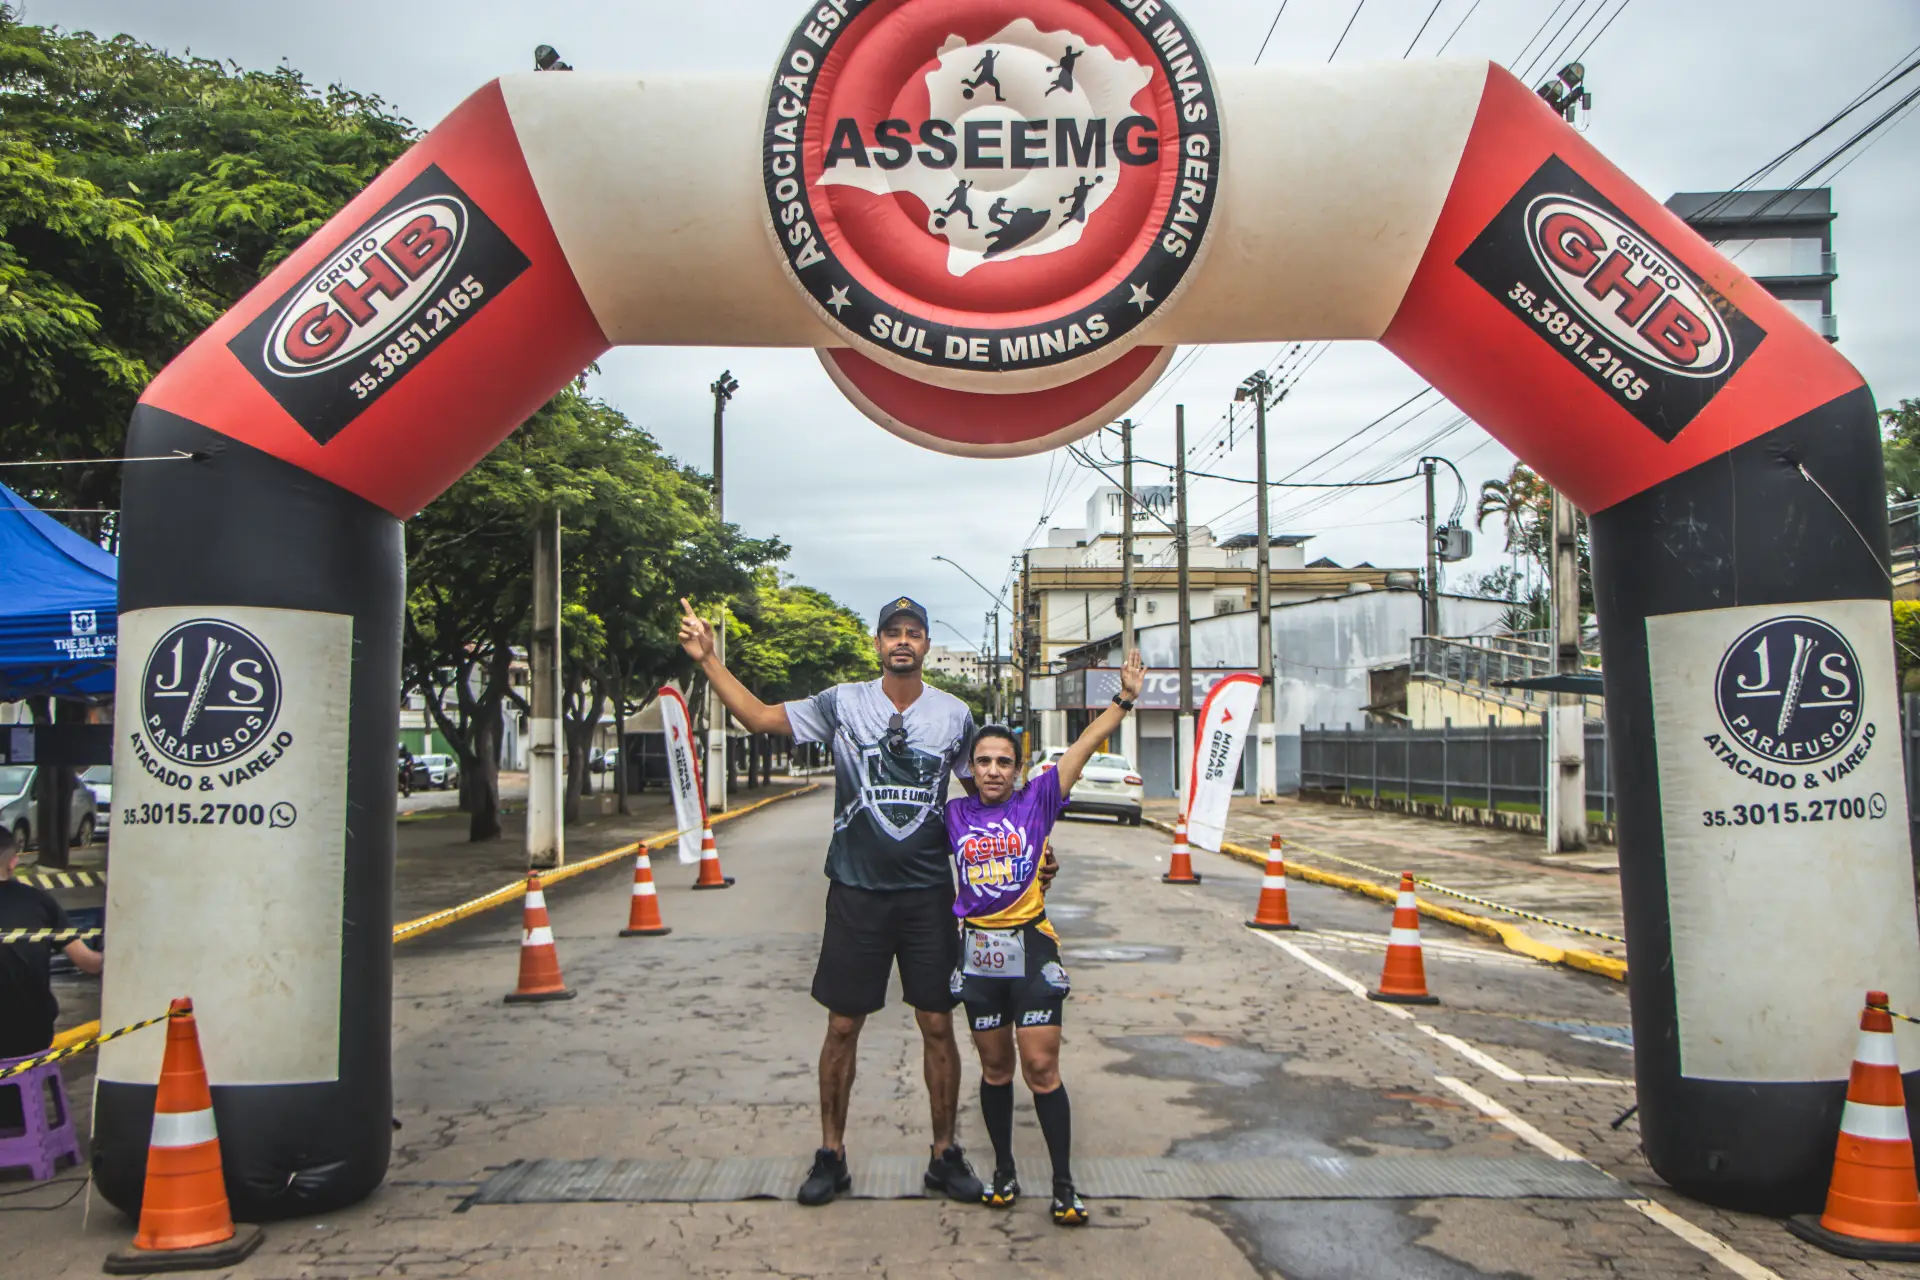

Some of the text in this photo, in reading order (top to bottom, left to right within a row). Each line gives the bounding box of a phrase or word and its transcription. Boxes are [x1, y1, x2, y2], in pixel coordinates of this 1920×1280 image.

[1152, 20, 1208, 123] MINAS
[772, 49, 827, 271] ASSOCIAÇÃO
[824, 116, 1159, 170] ASSEEMG
[1162, 136, 1210, 259] GERAIS
[284, 214, 455, 364] GHB
[315, 237, 378, 293] GRUPO
[1539, 212, 1711, 366] GHB
[1616, 235, 1681, 291] GRUPO
[349, 274, 485, 399] 35.3851.2165
[869, 313, 1110, 363] SUL DE MINAS
[1507, 281, 1650, 401] 35.3851.2165
[54, 636, 117, 651] THE BLACK
[148, 713, 263, 760] PARAFUSOS
[1205, 730, 1223, 781] GERAIS
[1216, 733, 1233, 779] MINAS
[1703, 722, 1877, 789] ATACADO & VAREJO
[1732, 708, 1854, 758] PARAFUSOS
[130, 731, 293, 792] ATACADO & VAREJO
[124, 802, 265, 826] 35.3015.2700
[875, 788, 901, 801] BOTA
[902, 788, 909, 800] É
[1703, 796, 1866, 827] 35.3015.2700
[973, 950, 1005, 969] 349
